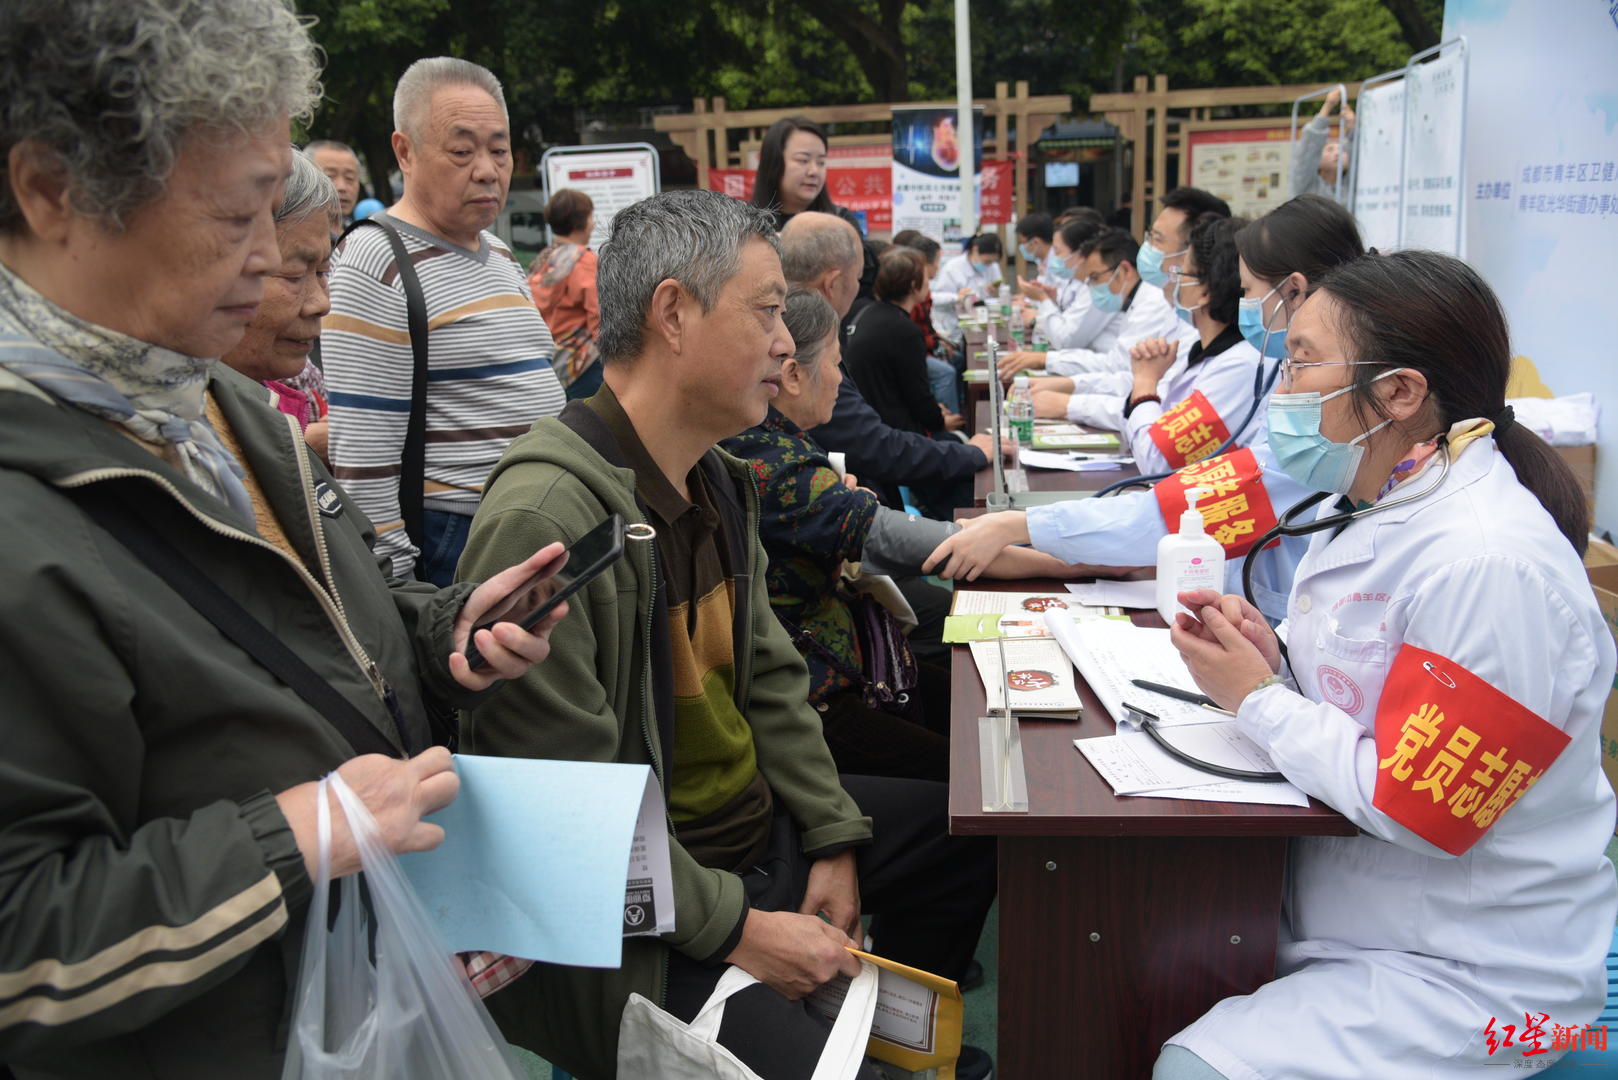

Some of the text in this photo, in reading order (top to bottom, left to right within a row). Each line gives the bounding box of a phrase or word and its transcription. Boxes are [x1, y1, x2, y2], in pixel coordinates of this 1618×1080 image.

[1521, 162, 1618, 184] 成都市青羊区卫健
[1476, 182, 1511, 200] 主办单位
[1379, 703, 1544, 829] 党员志愿
